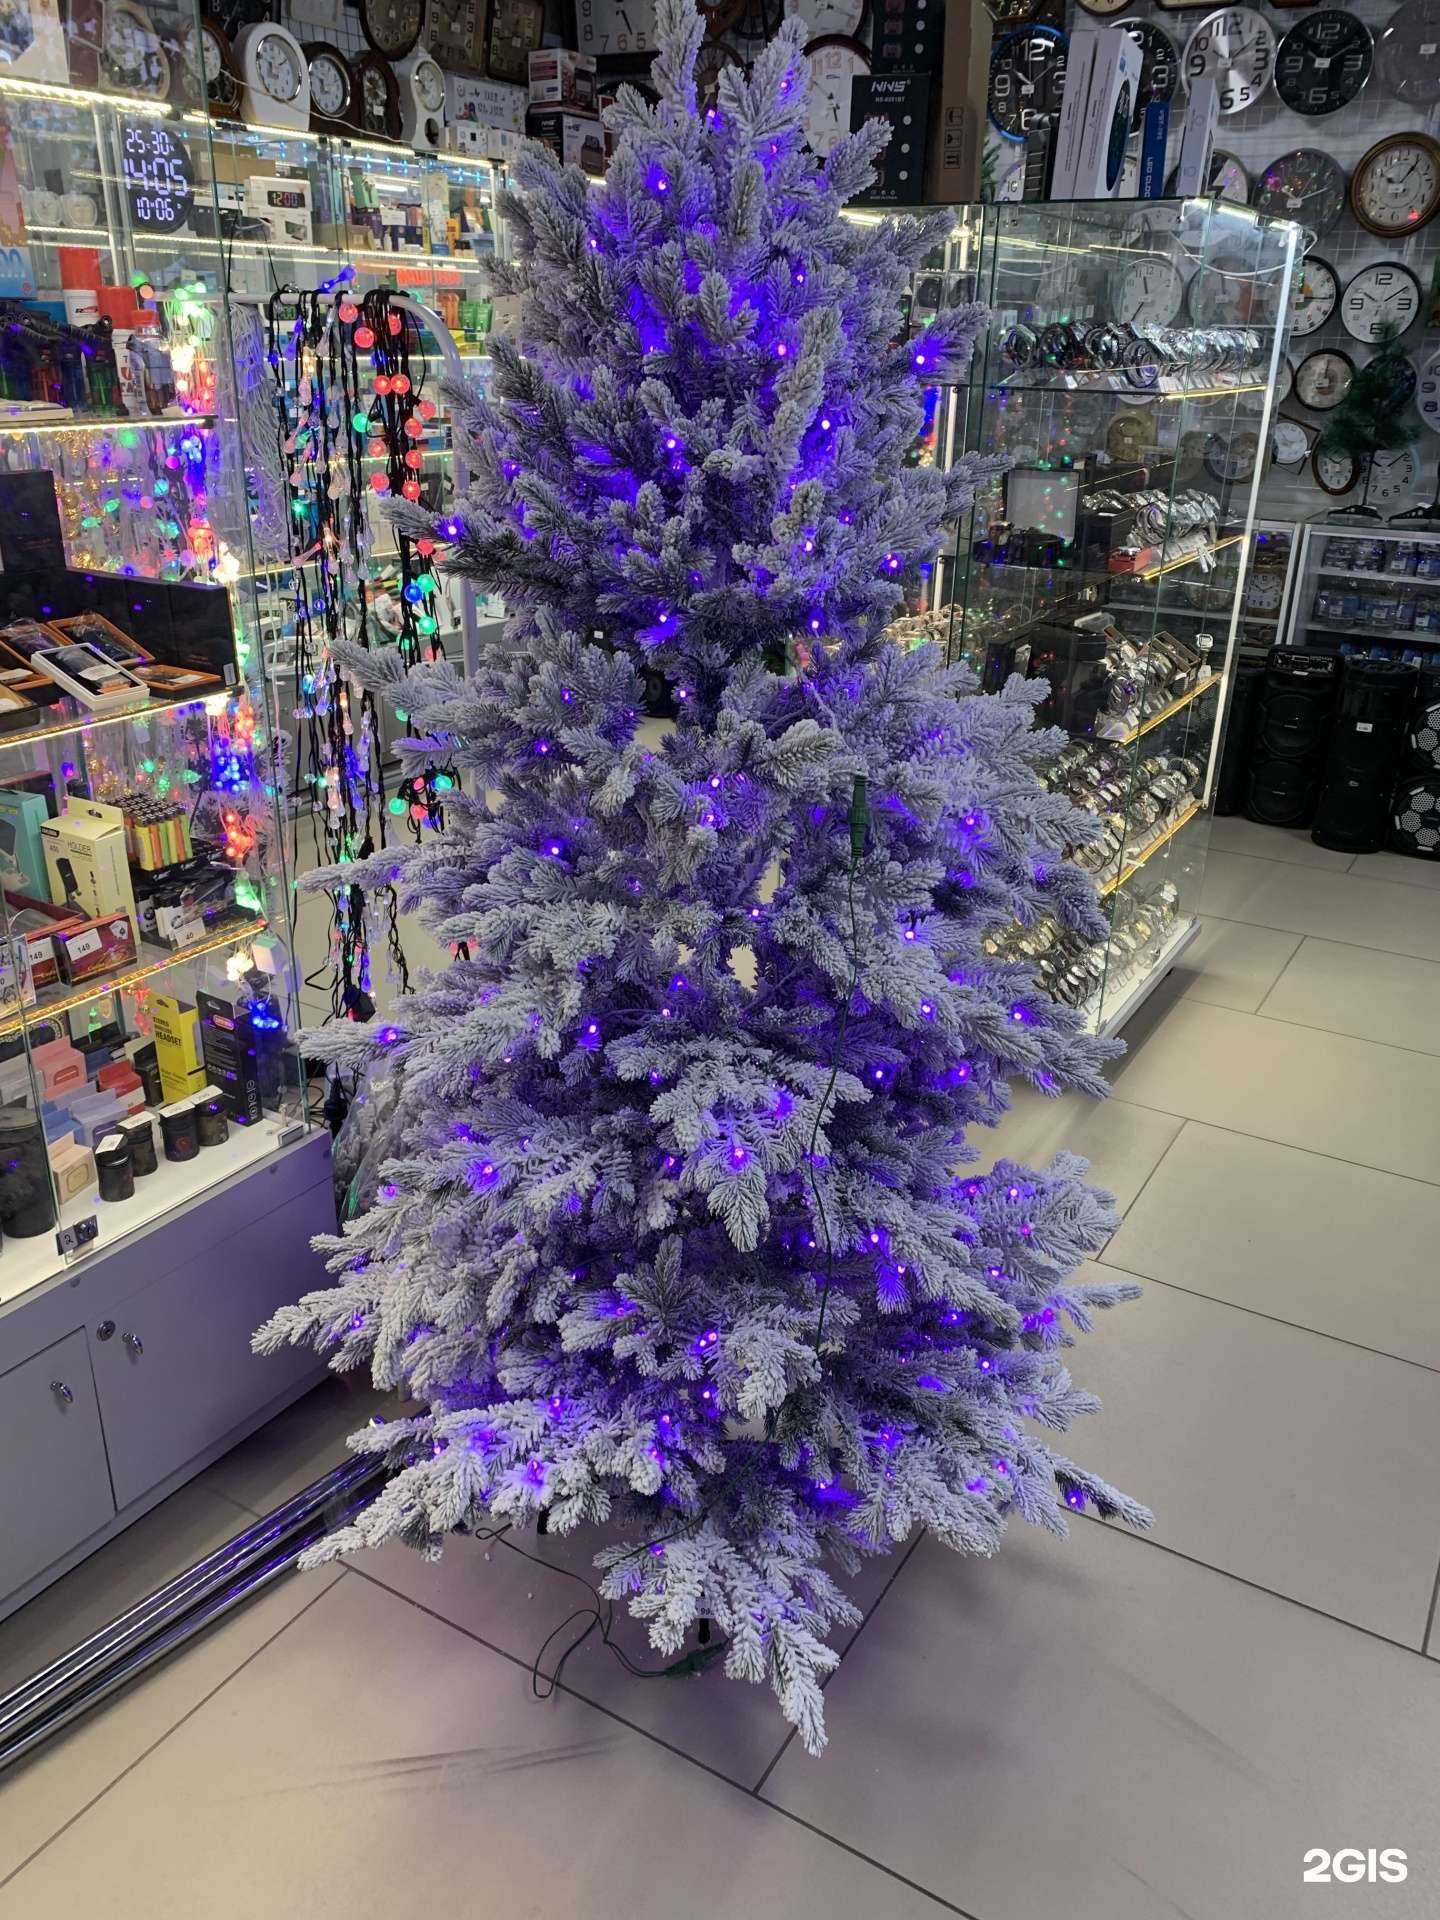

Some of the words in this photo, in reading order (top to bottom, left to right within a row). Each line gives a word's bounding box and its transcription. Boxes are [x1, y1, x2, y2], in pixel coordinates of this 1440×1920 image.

[584, 24, 592, 41] 8
[1256, 30, 1266, 45] 2
[1316, 23, 1340, 40] 12
[600, 34, 609, 52] 7
[618, 33, 627, 51] 6
[637, 32, 646, 50] 5
[1194, 36, 1209, 52] 10
[1021, 38, 1047, 61] 12
[1190, 54, 1206, 77] 9
[1254, 48, 1270, 71] 3
[1285, 56, 1303, 73] 9
[1344, 54, 1363, 71] 3
[1152, 65, 1169, 88] 3
[1251, 73, 1263, 87] 4
[995, 74, 1010, 96] 9
[1220, 88, 1235, 110] 6
[1240, 86, 1250, 101] 5
[1309, 87, 1328, 104] 6
[998, 102, 1006, 112] 8
[1007, 114, 1016, 130] 7
[124, 158, 187, 196] 14:05
[1375, 272, 1393, 285] 12
[1350, 298, 1364, 310] 9
[1397, 298, 1412, 310] 3
[1421, 381, 1436, 393] 9
[1424, 401, 1438, 412] 8
[1406, 464, 1413, 473] 3
[1402, 476, 1409, 484] 4
[1371, 485, 1378, 493] 7
[1382, 489, 1389, 497] 6
[1393, 485, 1400, 493] 5
[29, 951, 43, 961] 149
[77, 943, 91, 954] 149
[155, 1031, 182, 1046] HEADSET
